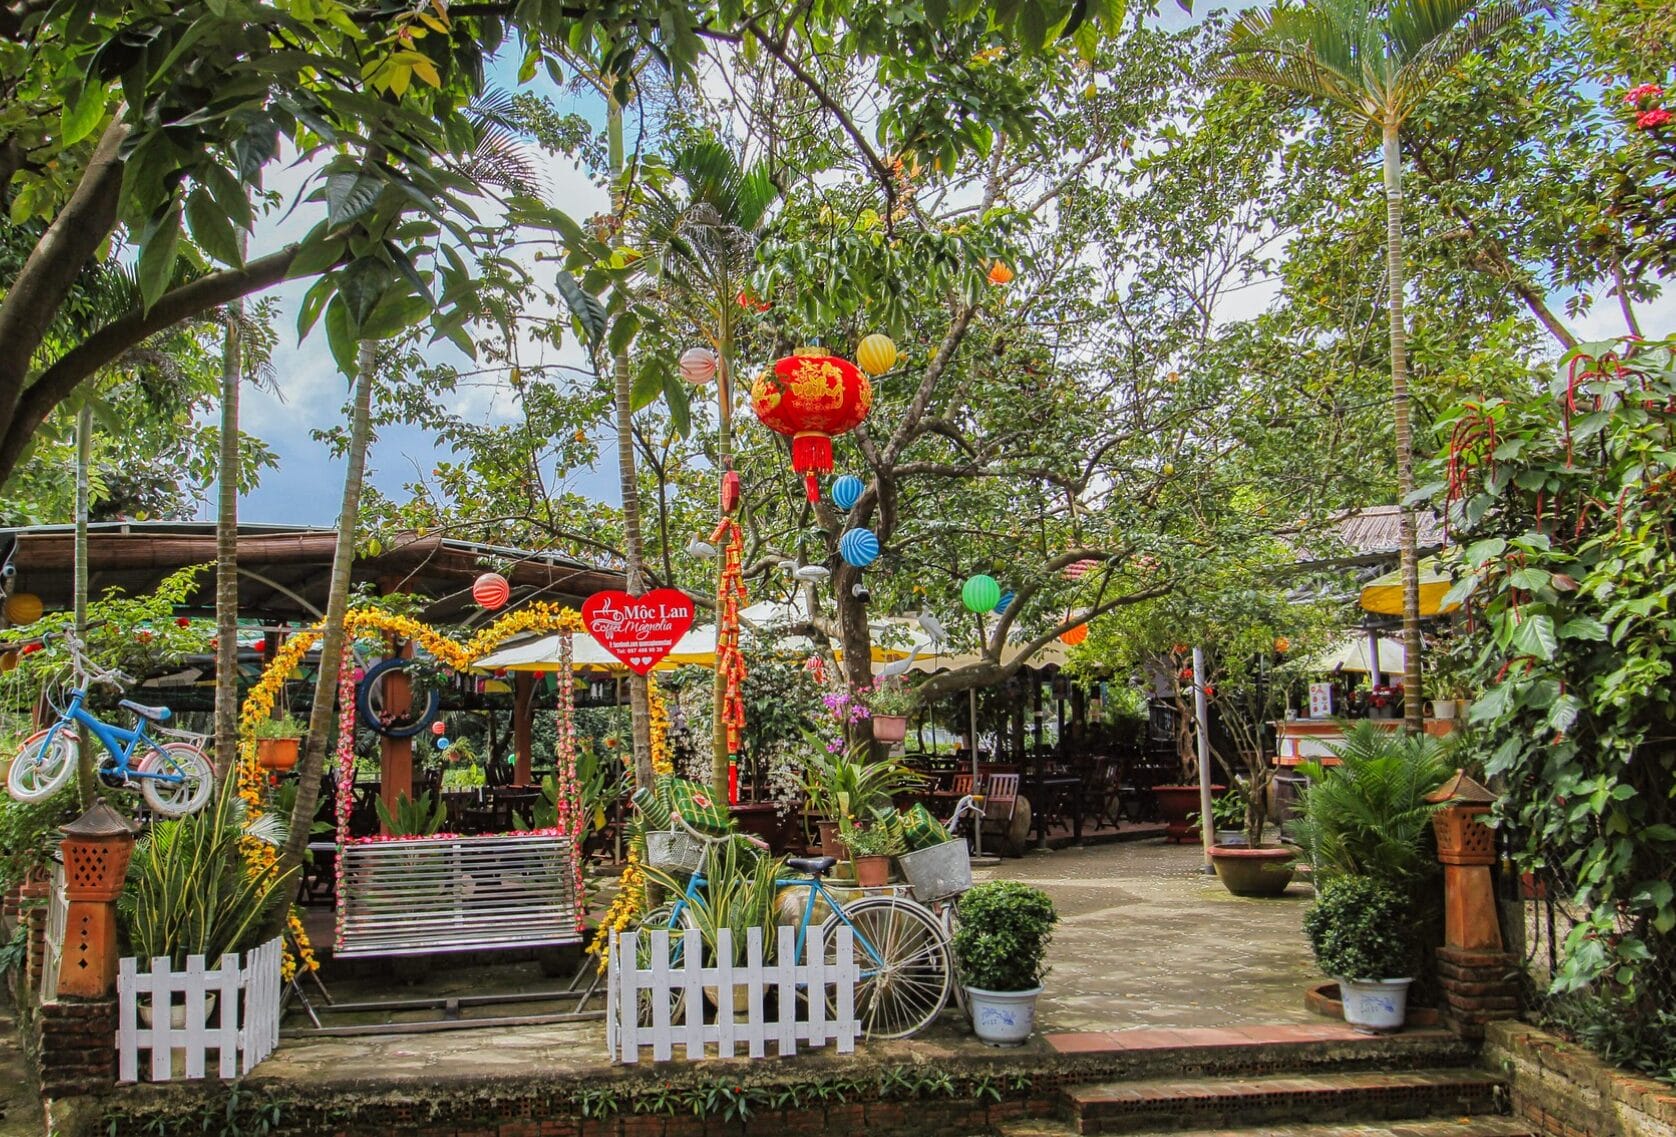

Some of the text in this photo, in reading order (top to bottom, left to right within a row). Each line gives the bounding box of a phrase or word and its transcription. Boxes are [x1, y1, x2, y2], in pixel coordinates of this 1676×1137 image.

[623, 604, 688, 622] Mộc Lan
[624, 618, 672, 640] Magnolia
